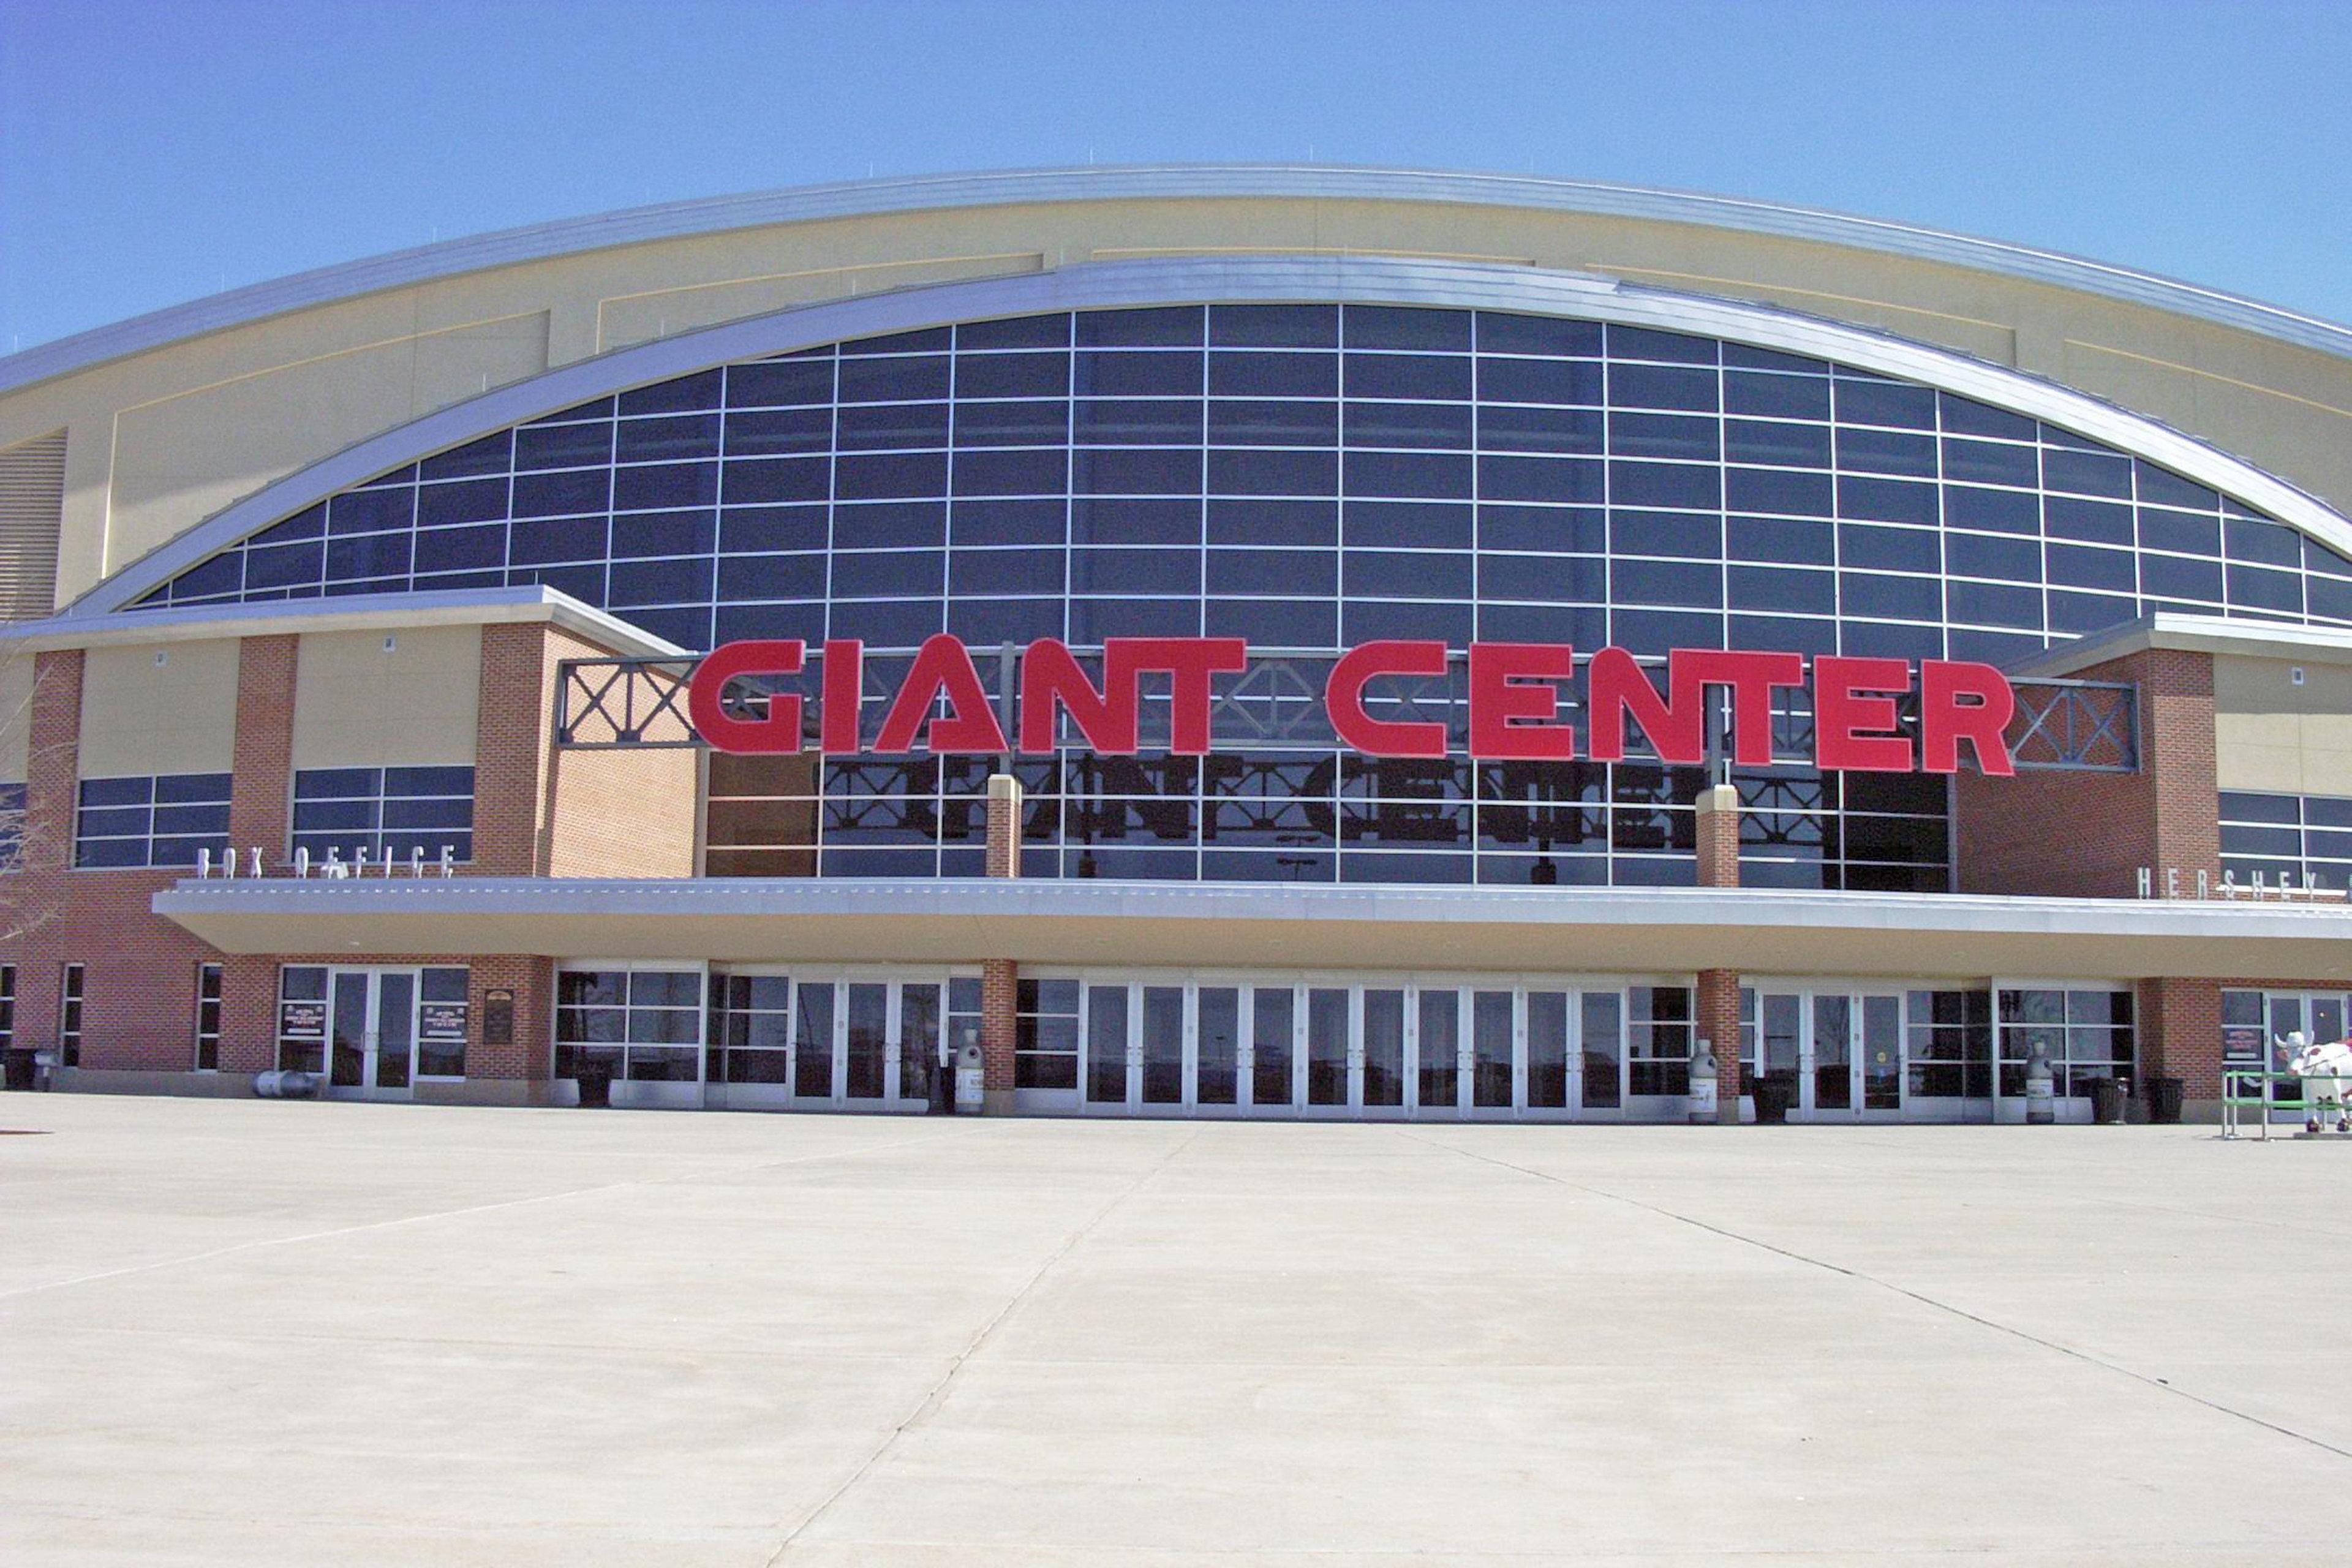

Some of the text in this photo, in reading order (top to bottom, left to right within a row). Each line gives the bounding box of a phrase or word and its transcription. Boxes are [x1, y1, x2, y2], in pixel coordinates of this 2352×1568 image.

[688, 632, 2016, 777] GIANT CENTER
[197, 845, 454, 879] BOX OFFICE
[2136, 867, 2317, 901] HERSHEY
